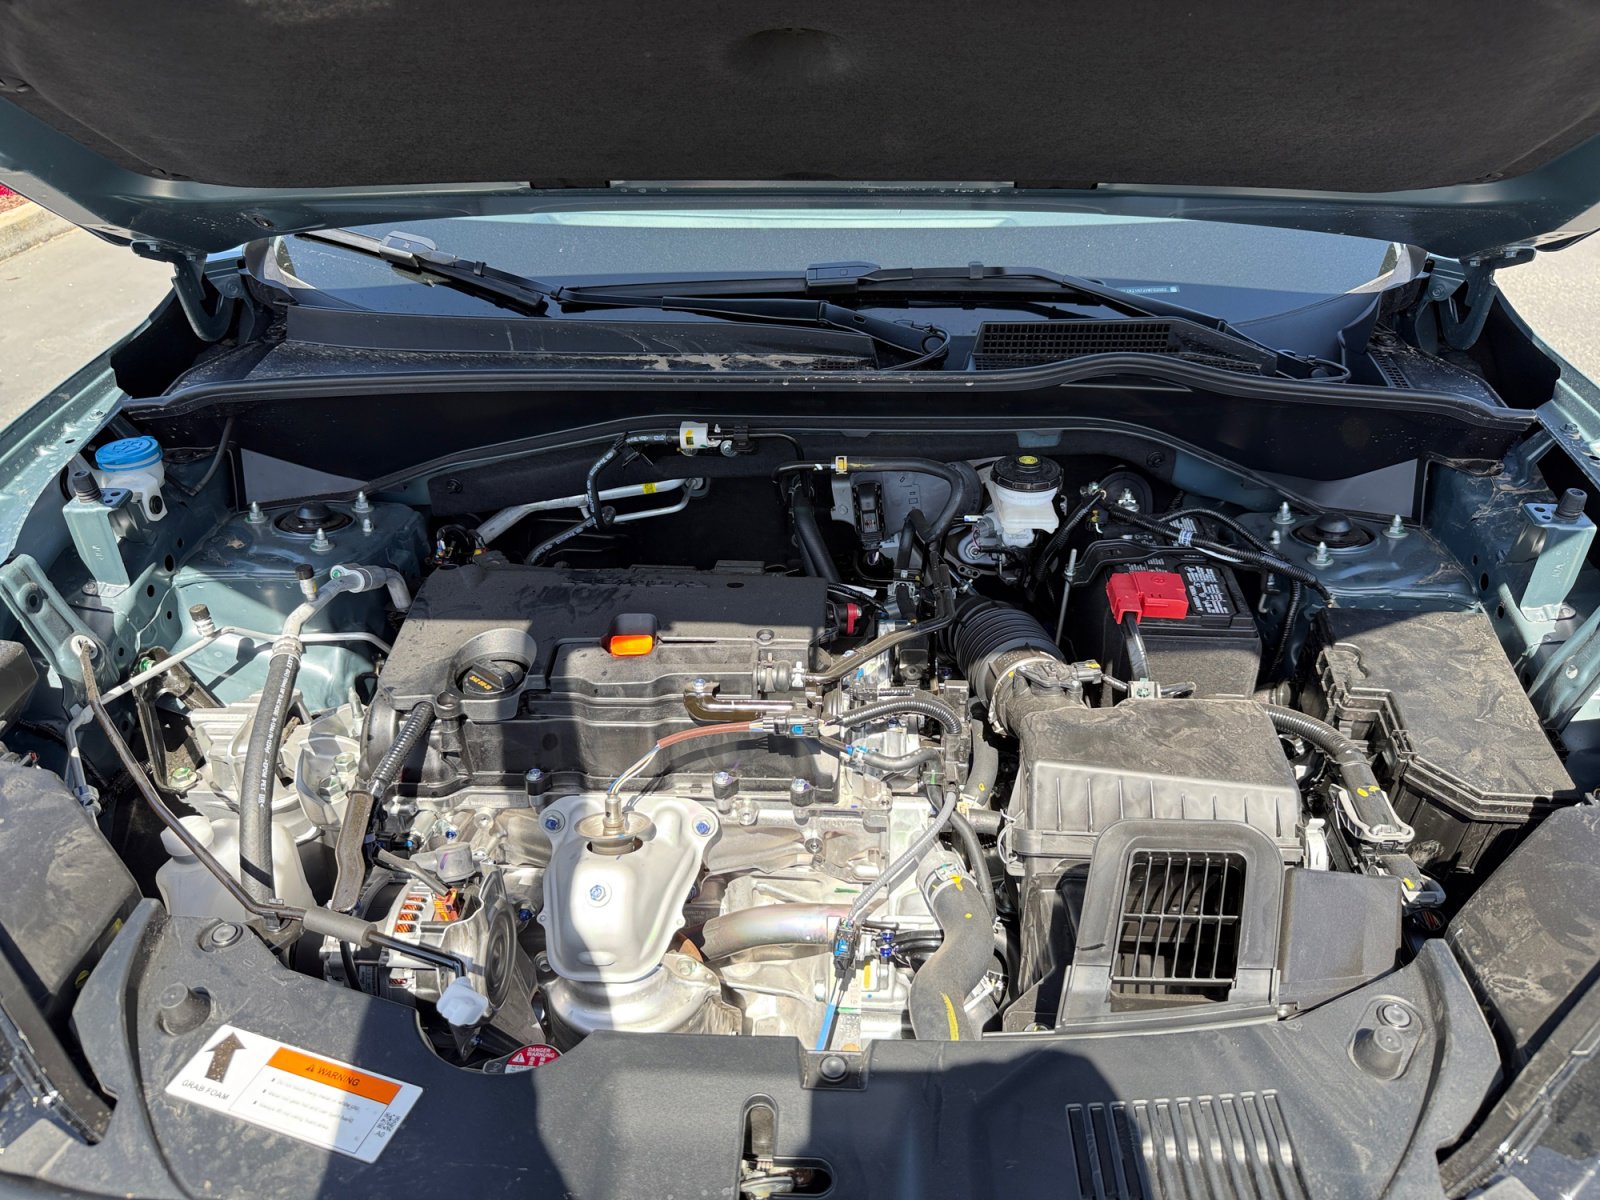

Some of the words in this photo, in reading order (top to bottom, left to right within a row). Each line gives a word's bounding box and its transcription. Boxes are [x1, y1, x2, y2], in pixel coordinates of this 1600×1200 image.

[318, 1066, 361, 1087] WARNING
[181, 1079, 206, 1092] GRAB
[204, 1087, 230, 1101] FOAM
